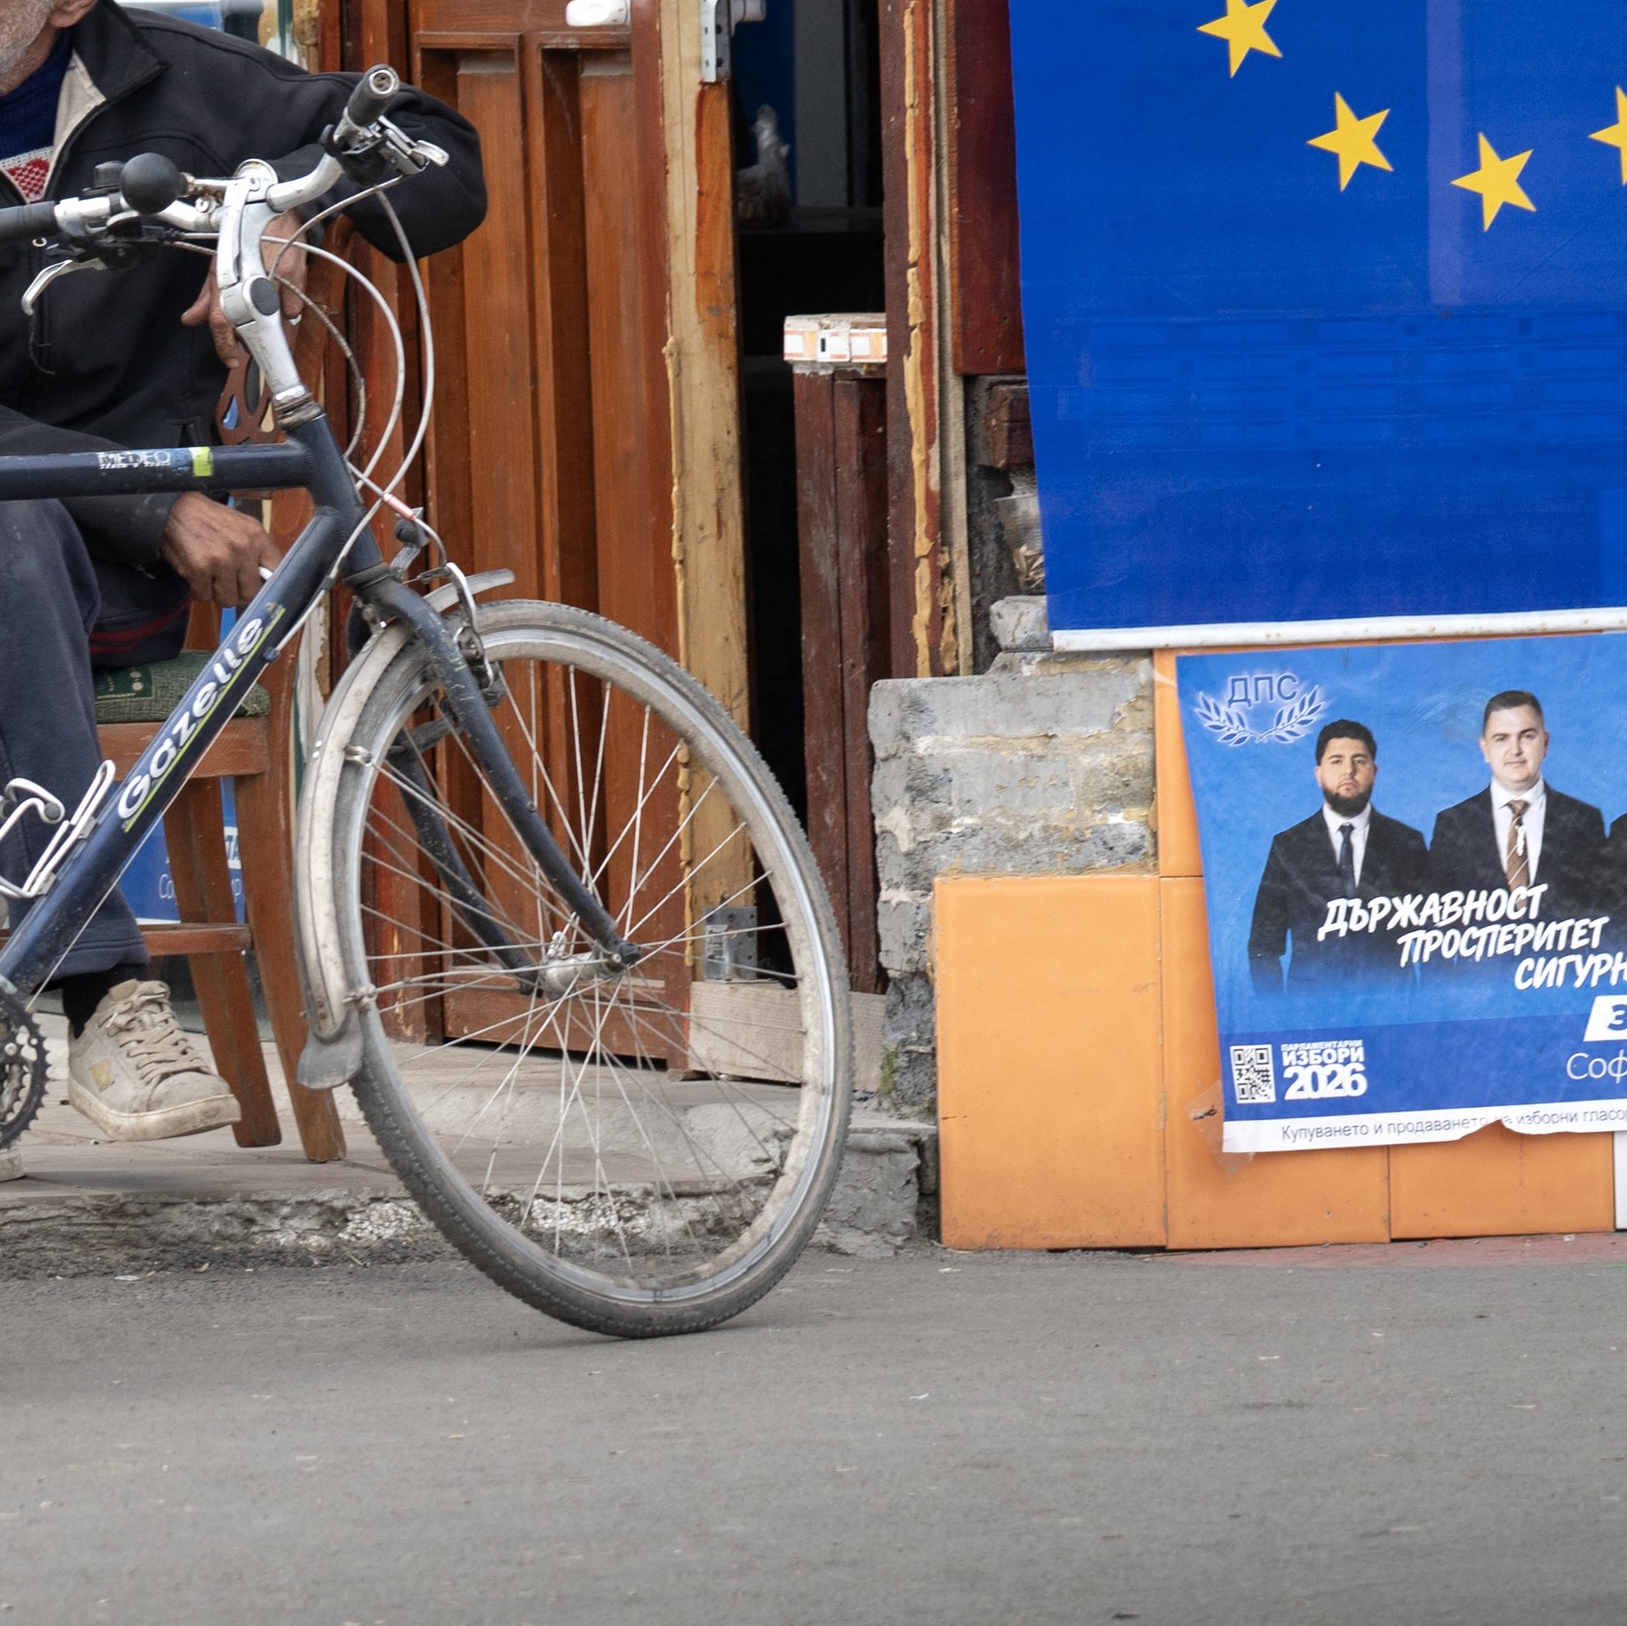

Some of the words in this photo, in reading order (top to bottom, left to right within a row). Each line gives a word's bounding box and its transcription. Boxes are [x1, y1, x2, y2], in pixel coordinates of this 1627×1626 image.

[1227, 673, 1299, 709] ДПС
[118, 618, 263, 819] Gazelle
[1317, 882, 1548, 942] ДЪРЖАВНОСТ
[1396, 917, 1609, 968] ПРОСПЕРИТЕТ
[1282, 1047, 1365, 1067] ИЗБОРИ
[1283, 1062, 1368, 1101] 2026
[1281, 1124, 1369, 1143] Купуването
[1374, 1124, 1384, 1134] и
[1387, 1117, 1489, 1137] продаването
[1516, 1110, 1578, 1129] изборни
